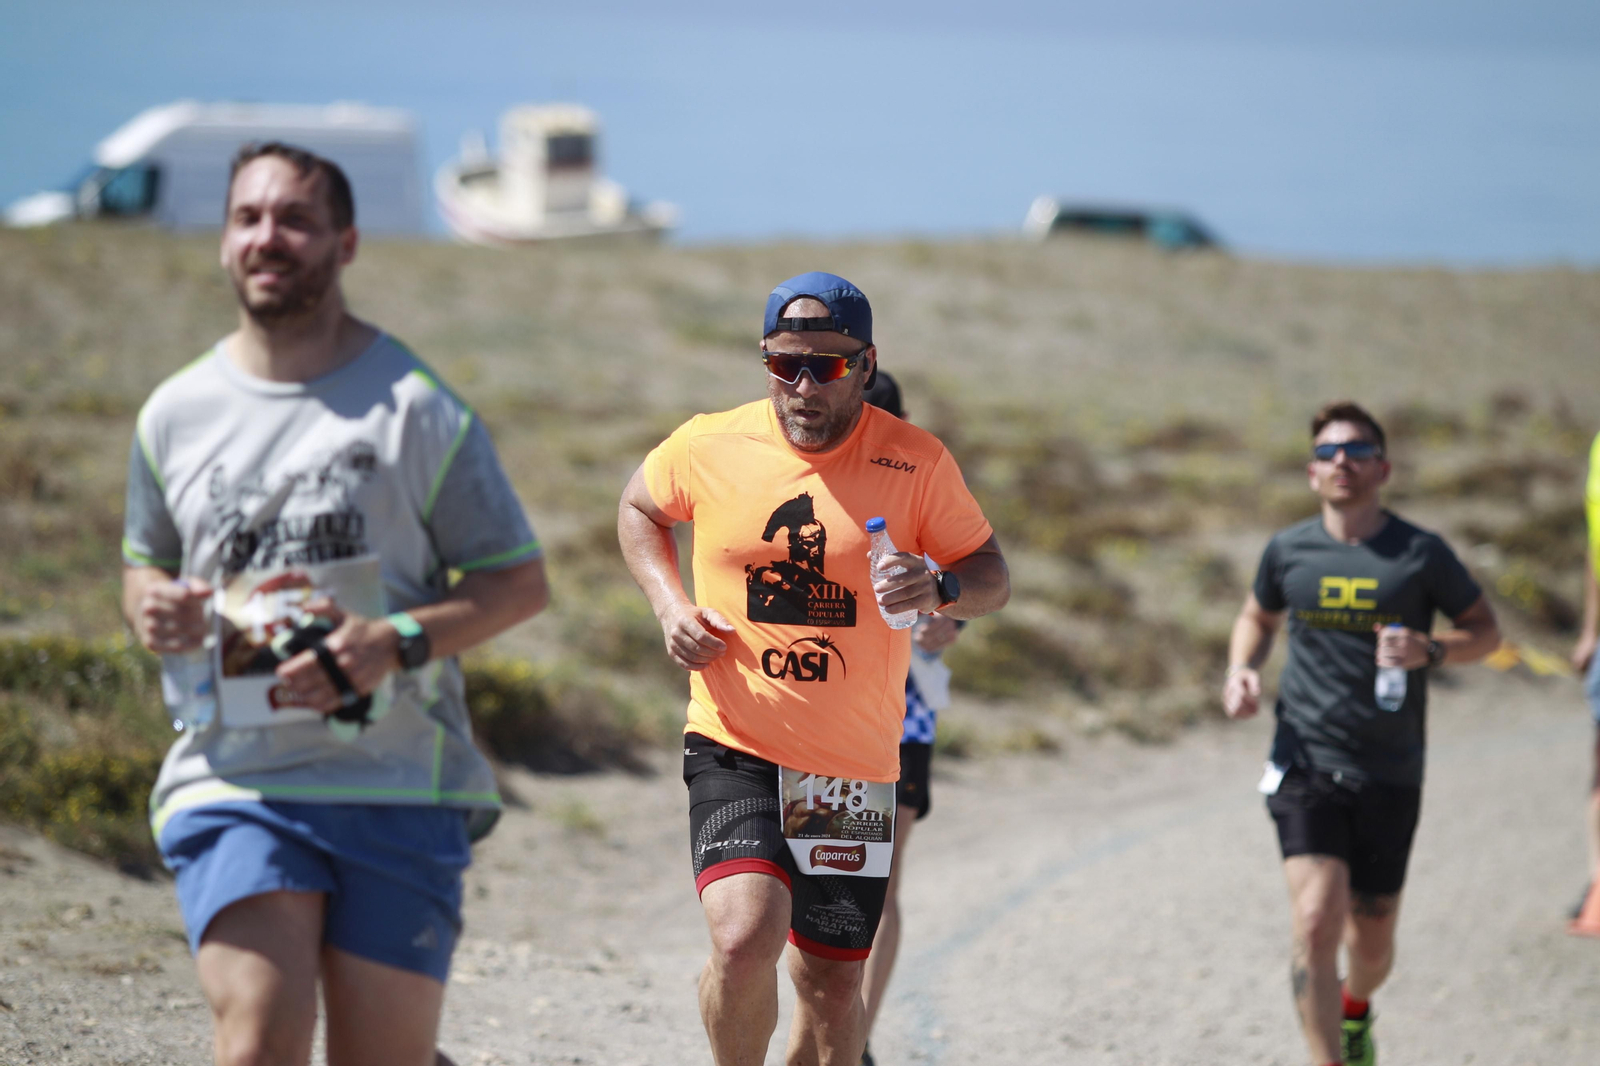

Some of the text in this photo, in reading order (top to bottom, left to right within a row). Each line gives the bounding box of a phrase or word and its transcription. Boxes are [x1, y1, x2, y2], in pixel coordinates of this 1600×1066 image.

[870, 457, 916, 474] JOLUVI
[808, 583, 845, 599] XIII
[808, 602, 846, 610] CARRERA
[761, 648, 829, 682] CASI
[798, 773, 868, 813] 148
[843, 810, 884, 822] XIII
[805, 914, 861, 932] MARATON
[820, 915, 848, 925] ULTRA
